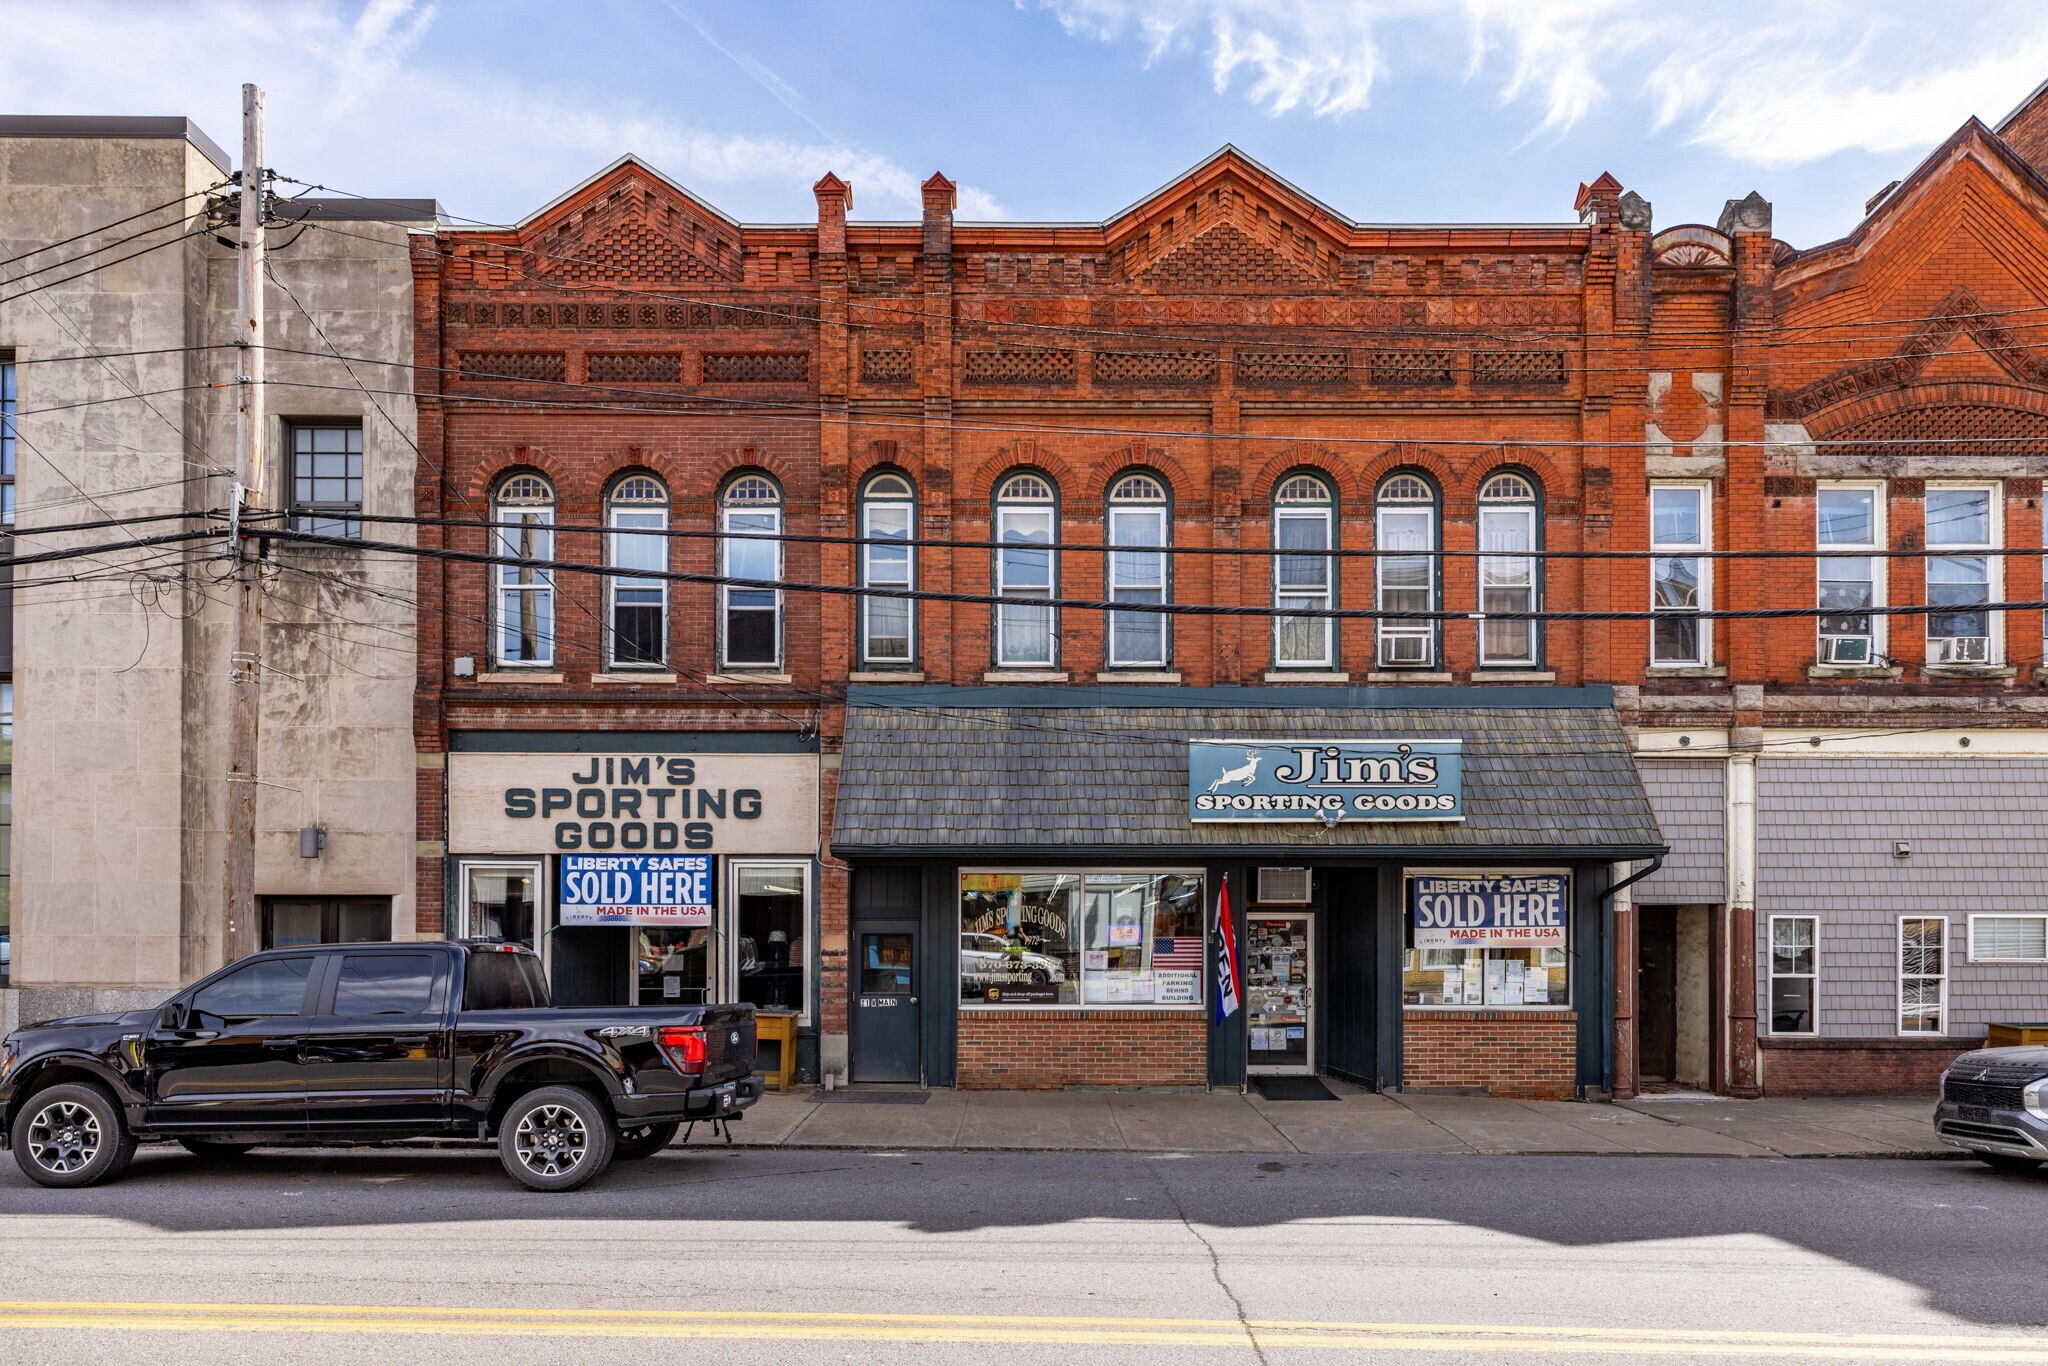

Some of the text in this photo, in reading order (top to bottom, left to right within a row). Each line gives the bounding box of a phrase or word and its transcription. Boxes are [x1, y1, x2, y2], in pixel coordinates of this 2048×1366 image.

[572, 755, 695, 785] JIM'S
[1275, 744, 1438, 784] Jim's
[504, 788, 762, 819] SPORTING
[1195, 794, 1456, 811] SPORTING GOODS
[555, 822, 713, 850] GOODS
[566, 857, 708, 870] LIBERTY SAFES
[566, 871, 707, 904] SOLD HERE
[1418, 879, 1560, 893] LIBERTY SAFES
[596, 906, 706, 915] MADE IN THE USA
[995, 905, 1038, 926] SPOING
[1038, 907, 1067, 939] GOODS
[1418, 894, 1560, 927] SOLD HERE
[1450, 928, 1560, 938] MADE IN THE USA
[878, 999, 897, 1007] MAIN
